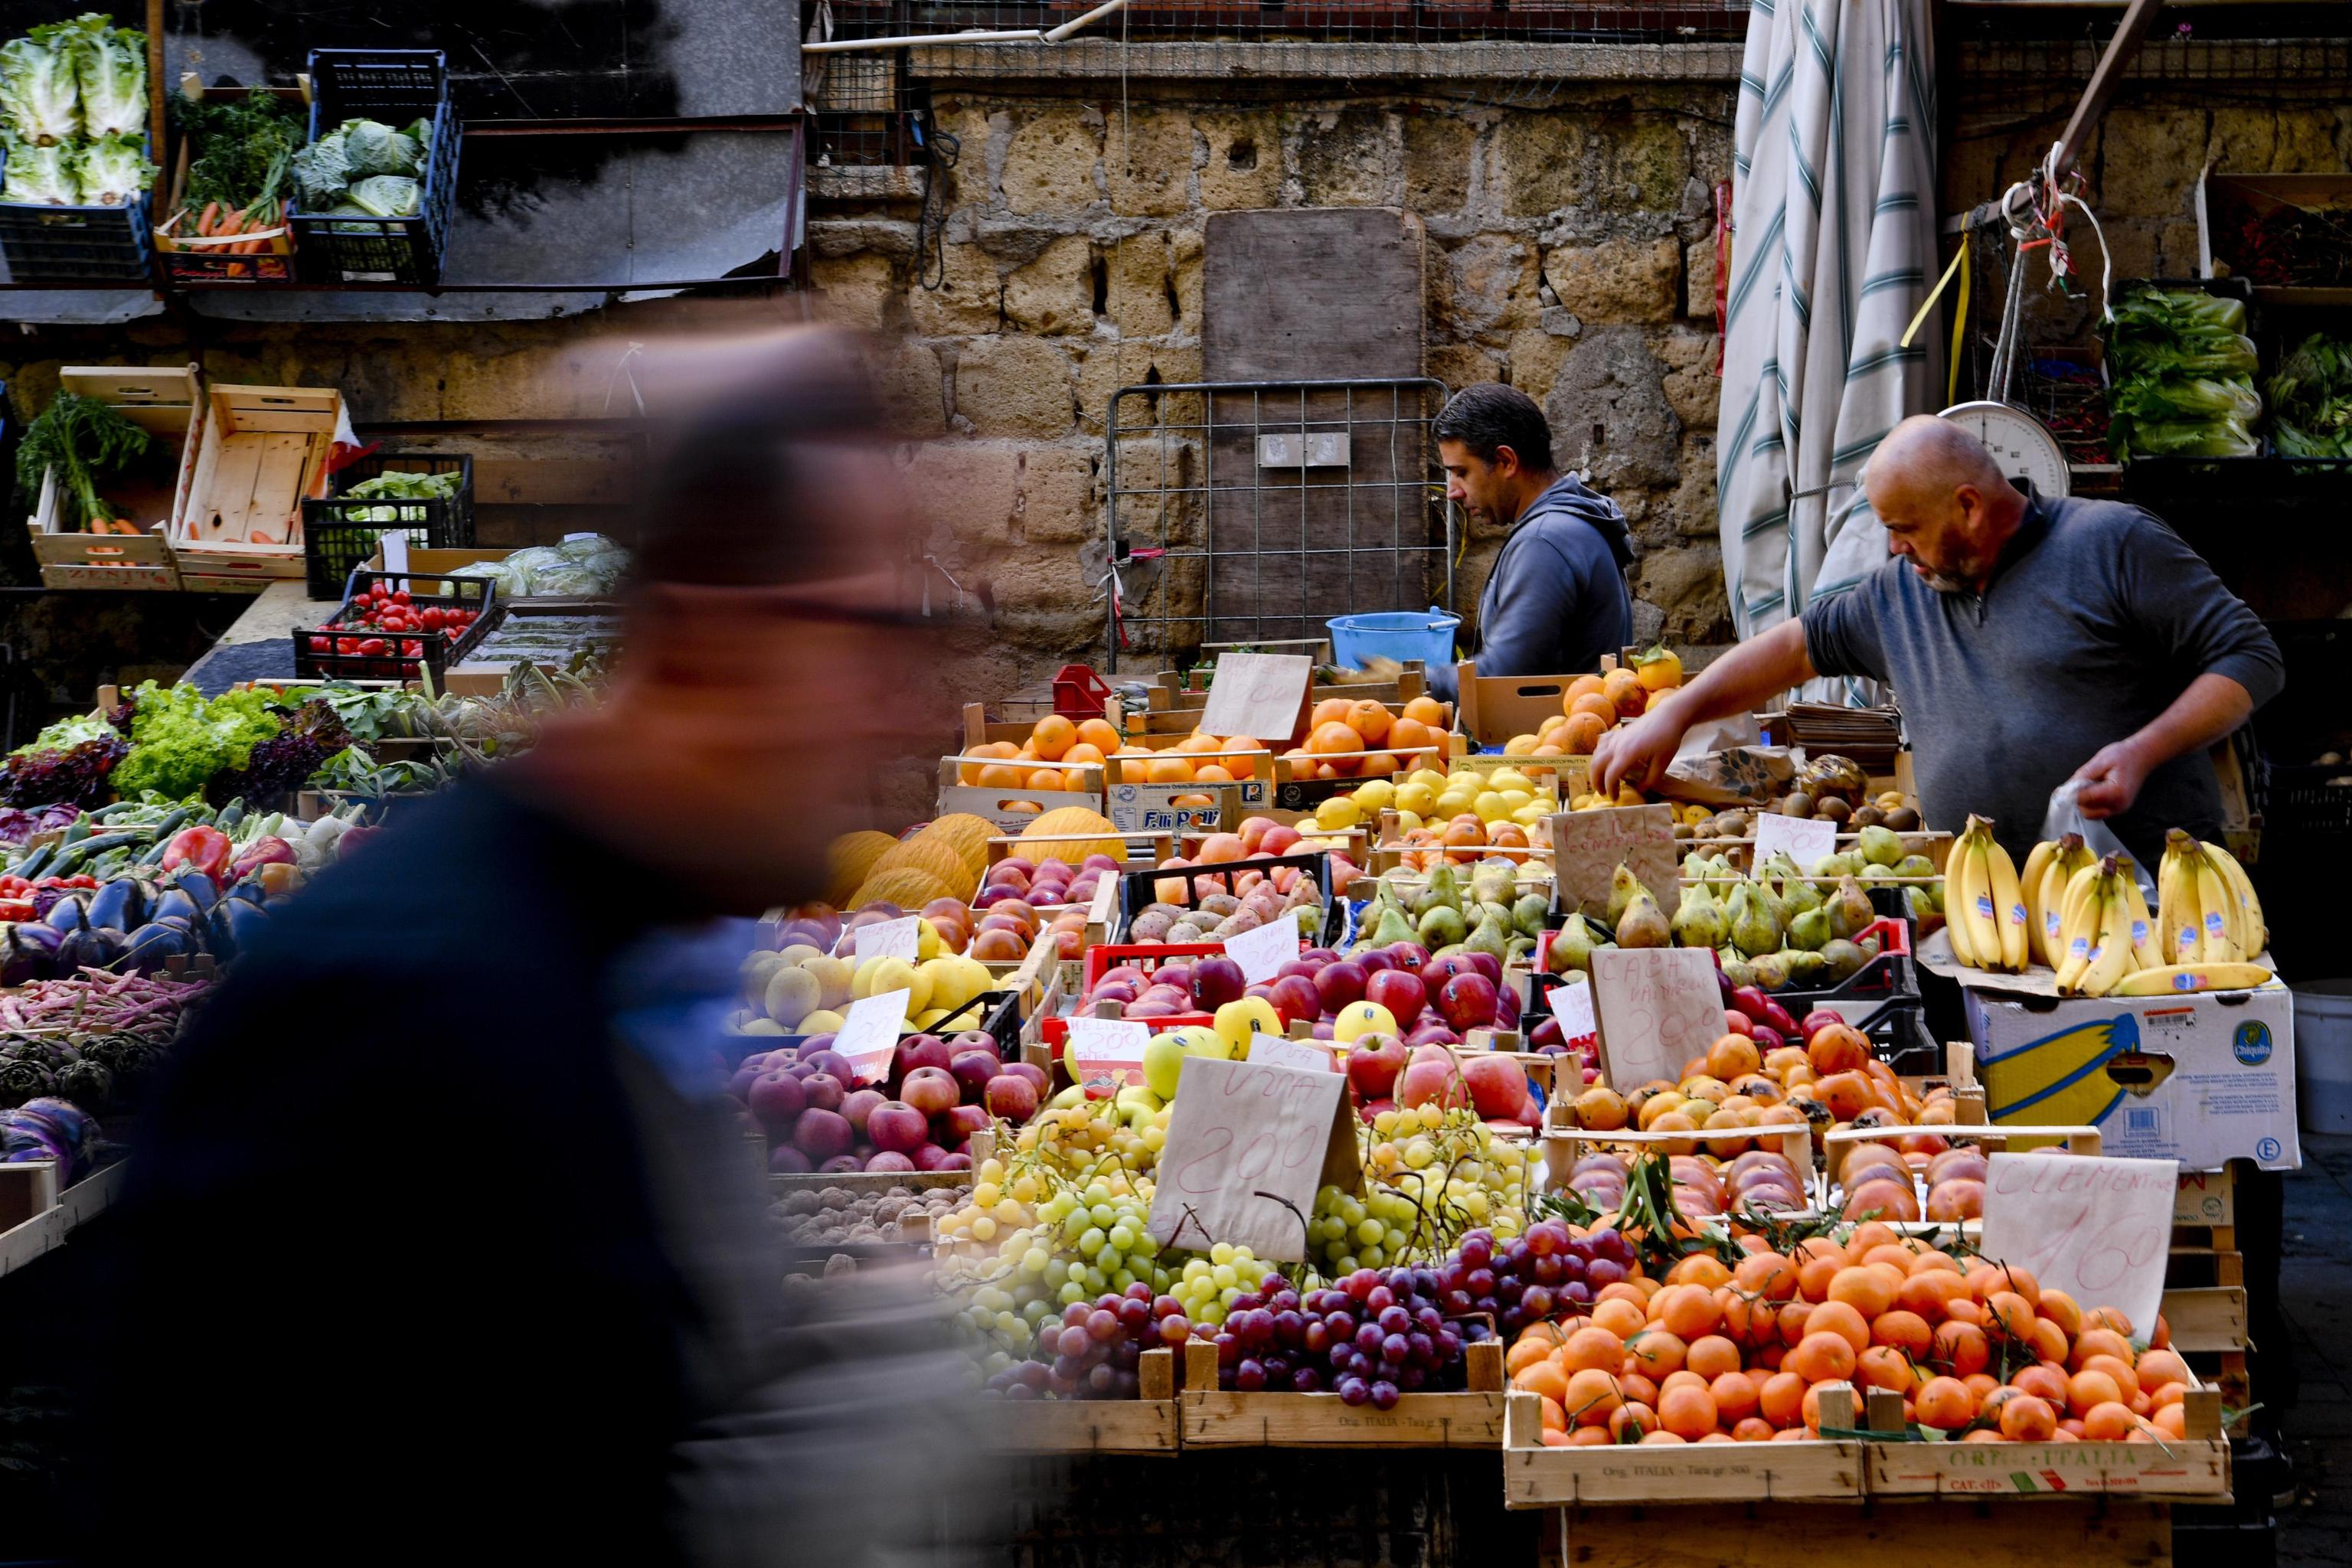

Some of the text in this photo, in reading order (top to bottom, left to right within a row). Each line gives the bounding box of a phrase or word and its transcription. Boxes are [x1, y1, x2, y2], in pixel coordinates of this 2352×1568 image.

[69, 569, 149, 580] ZENIT
[1088, 1032, 1140, 1053] 200
[2234, 1044, 2271, 1058] Chiquita
[1177, 1125, 1318, 1194] 200
[2029, 1205, 2161, 1291] 160
[2043, 1449, 2137, 1465] ITALIA
[1633, 1465, 1675, 1476] ITALIA
